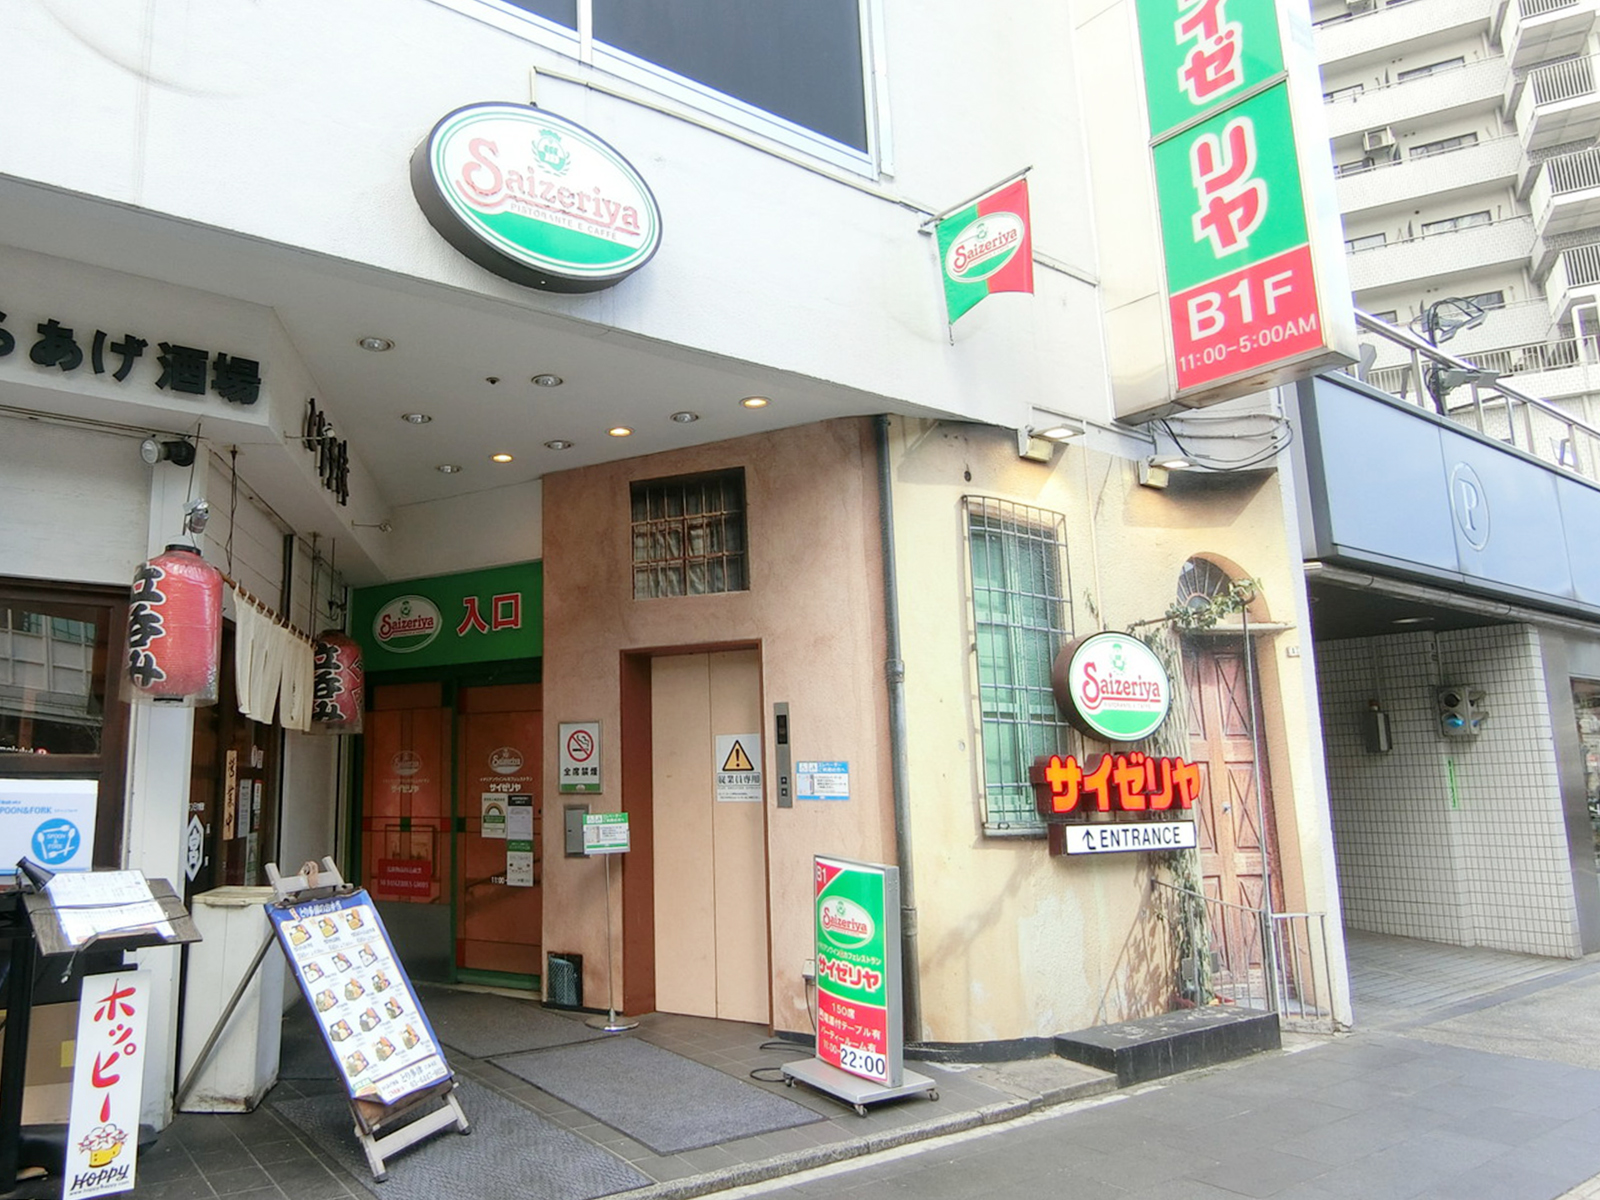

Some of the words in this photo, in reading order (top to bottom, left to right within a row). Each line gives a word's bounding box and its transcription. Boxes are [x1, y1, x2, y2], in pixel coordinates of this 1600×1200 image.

[456, 137, 641, 236] Saizeriya
[953, 228, 1018, 273] Saizeriya
[1187, 270, 1293, 341] B1F
[379, 614, 434, 640] Saizeriya
[457, 594, 521, 636] 入口
[1080, 662, 1161, 710] Saizeriya
[563, 766, 598, 777] 全席禁煙
[1045, 751, 1201, 813] サイゼリヤ
[0, 806, 51, 815] POON&FORK
[1100, 826, 1181, 848] ENTRANCE
[822, 906, 868, 935] Saizeriya
[818, 954, 882, 992] サイゼリヤ
[92, 978, 137, 1123] ホッピー
[840, 1047, 885, 1075] 22:00
